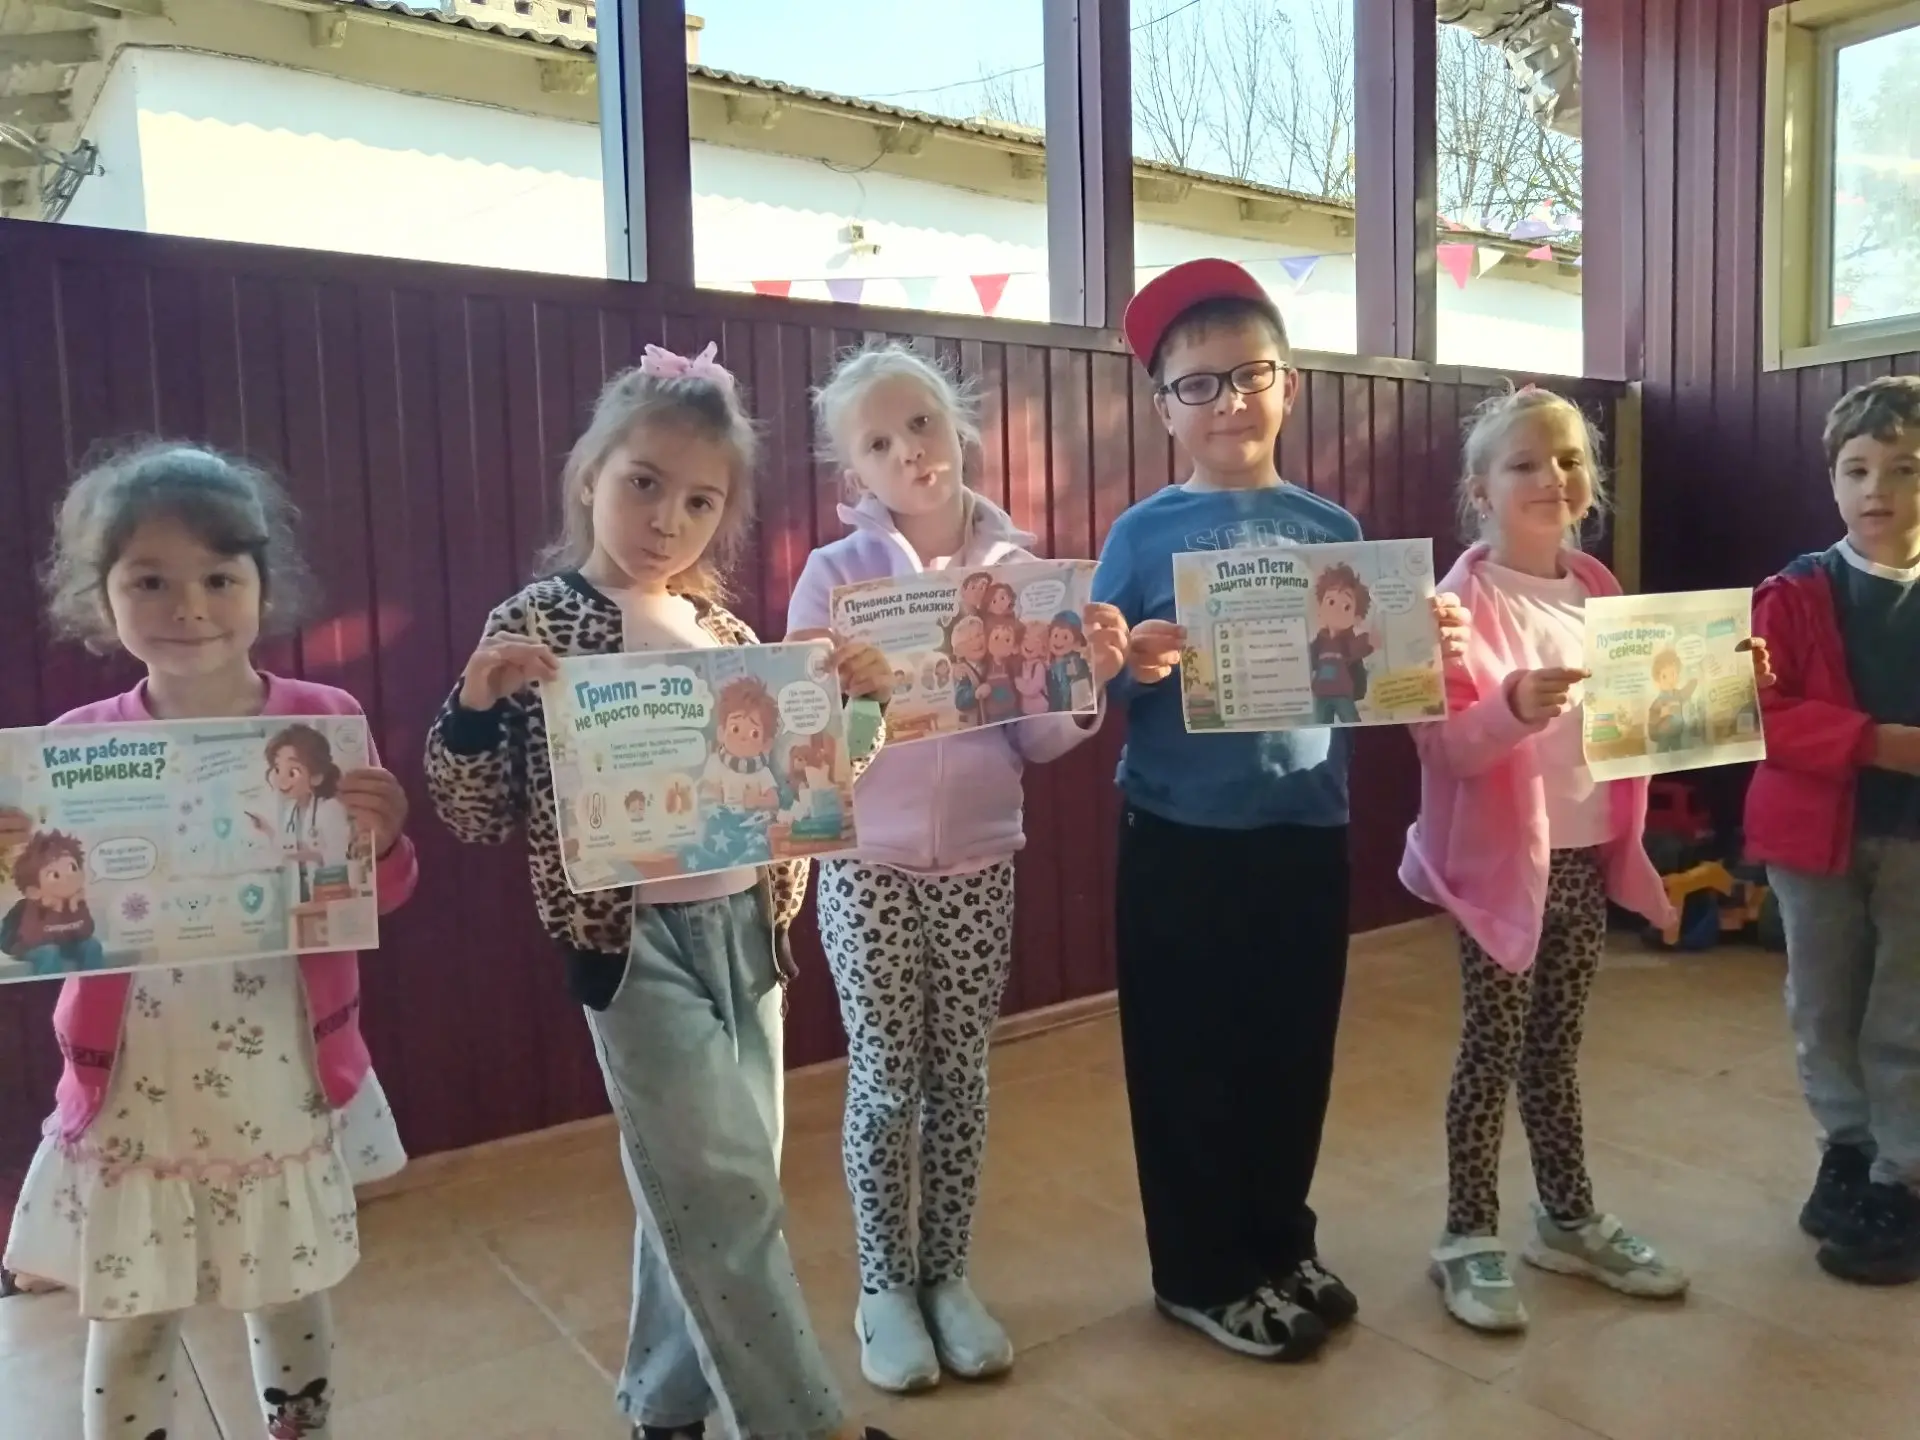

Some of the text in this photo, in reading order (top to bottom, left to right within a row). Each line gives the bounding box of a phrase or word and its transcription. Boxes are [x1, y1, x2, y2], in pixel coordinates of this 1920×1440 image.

[1216, 557, 1294, 580] План Пети
[1208, 574, 1309, 594] защиты от гриппа
[844, 588, 957, 614] Прививка помогает
[850, 602, 955, 626] защитить близких
[1609, 642, 1653, 660] сейчас!
[575, 680, 637, 712] Грипп
[660, 677, 693, 696] это
[575, 702, 704, 731] не просто простуда
[43, 738, 168, 768] Как работает
[51, 757, 166, 789] прививка?
